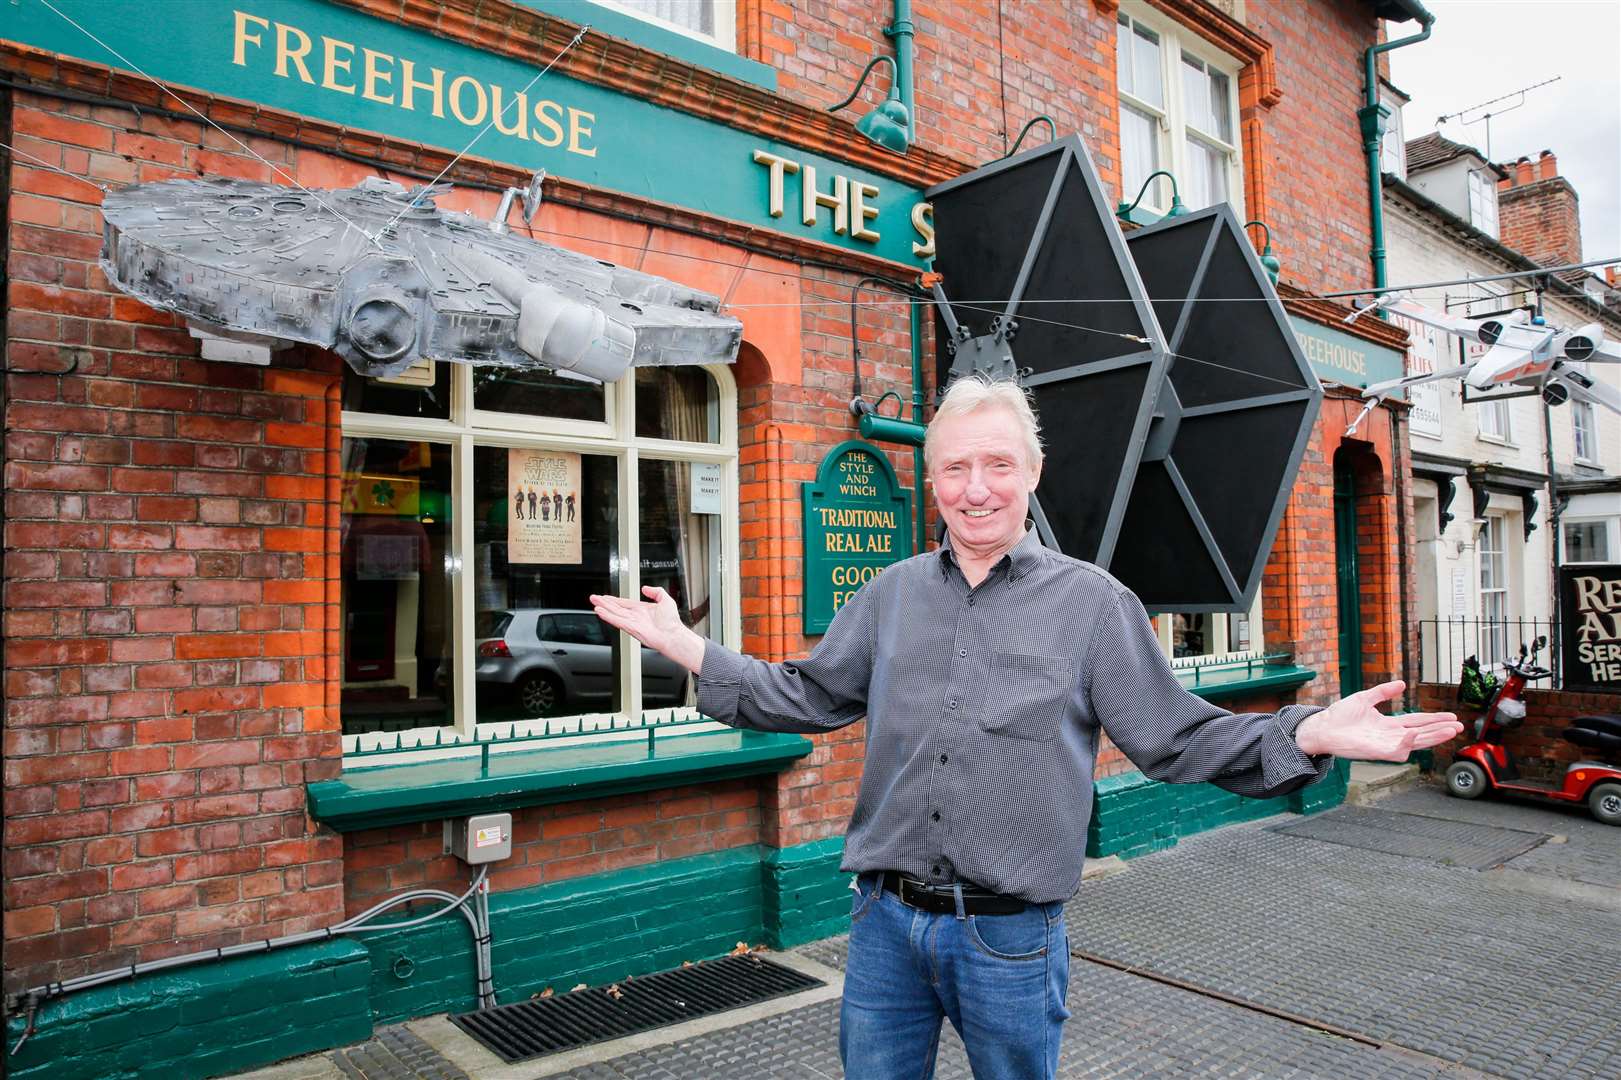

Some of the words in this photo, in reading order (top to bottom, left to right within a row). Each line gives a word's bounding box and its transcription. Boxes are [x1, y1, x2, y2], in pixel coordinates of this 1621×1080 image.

[232, 9, 598, 158] FREEHOUSE
[753, 149, 881, 242] THE
[1296, 332, 1366, 376] REEHOUSE
[524, 456, 567, 470] STYLE
[847, 452, 867, 463] THE
[527, 469, 567, 481] WARS
[839, 462, 874, 474] STYLE
[845, 474, 869, 485] AND
[839, 484, 877, 497] WINCH
[819, 508, 897, 529] TRADITIONAL
[826, 532, 863, 553] REAL
[866, 534, 892, 553] ALE
